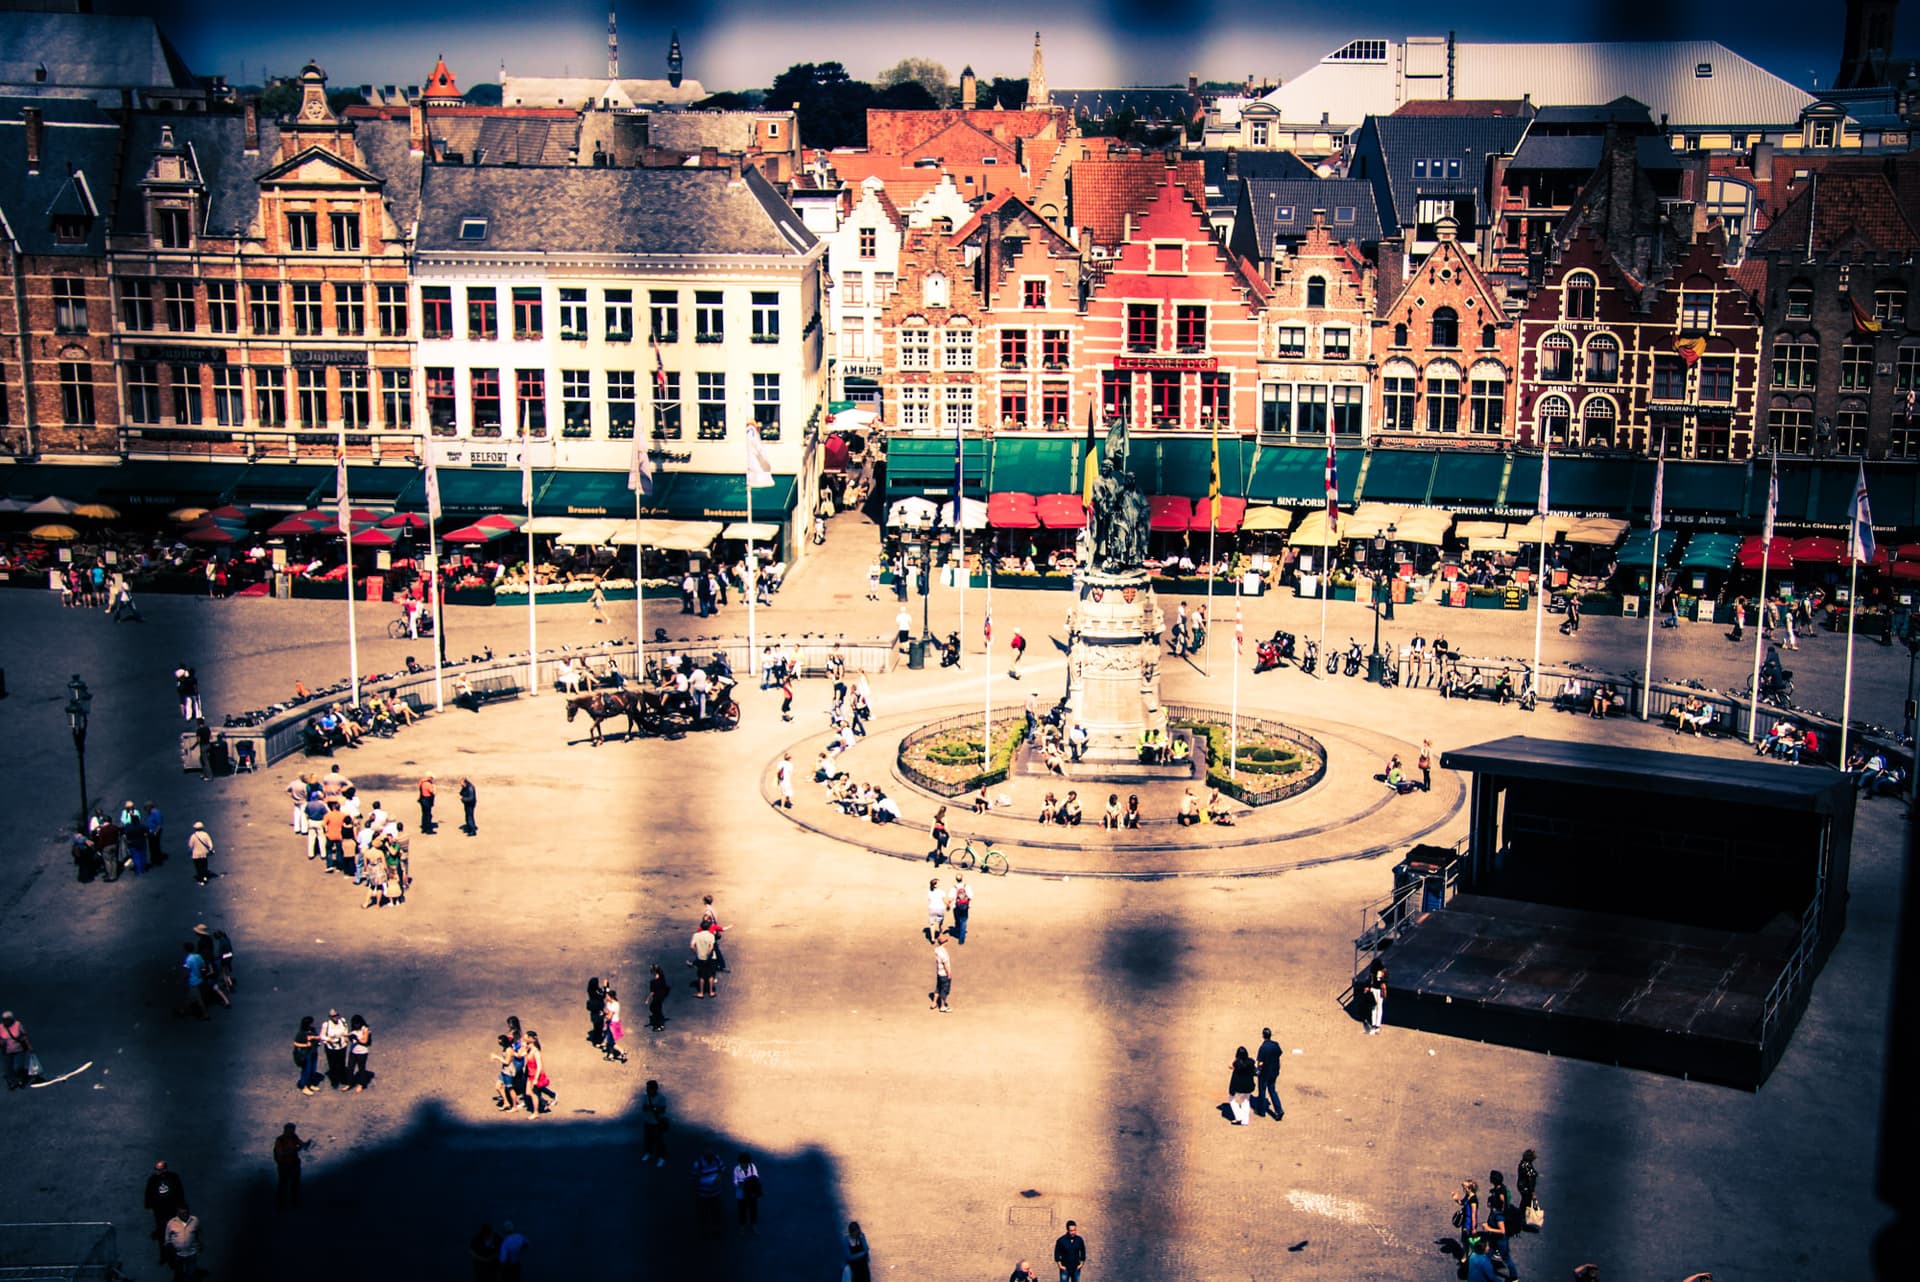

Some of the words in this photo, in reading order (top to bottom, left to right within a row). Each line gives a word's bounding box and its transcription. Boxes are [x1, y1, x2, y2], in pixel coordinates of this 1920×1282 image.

[307, 349, 352, 365] Jupiler
[1119, 359, 1134, 368] LE
[1138, 359, 1183, 369] PANIER
[470, 452, 508, 462] BELFORT
[1277, 496, 1326, 507] SINT-JORIS
[1673, 515, 1695, 524] DES
[1697, 515, 1727, 525] ARTS
